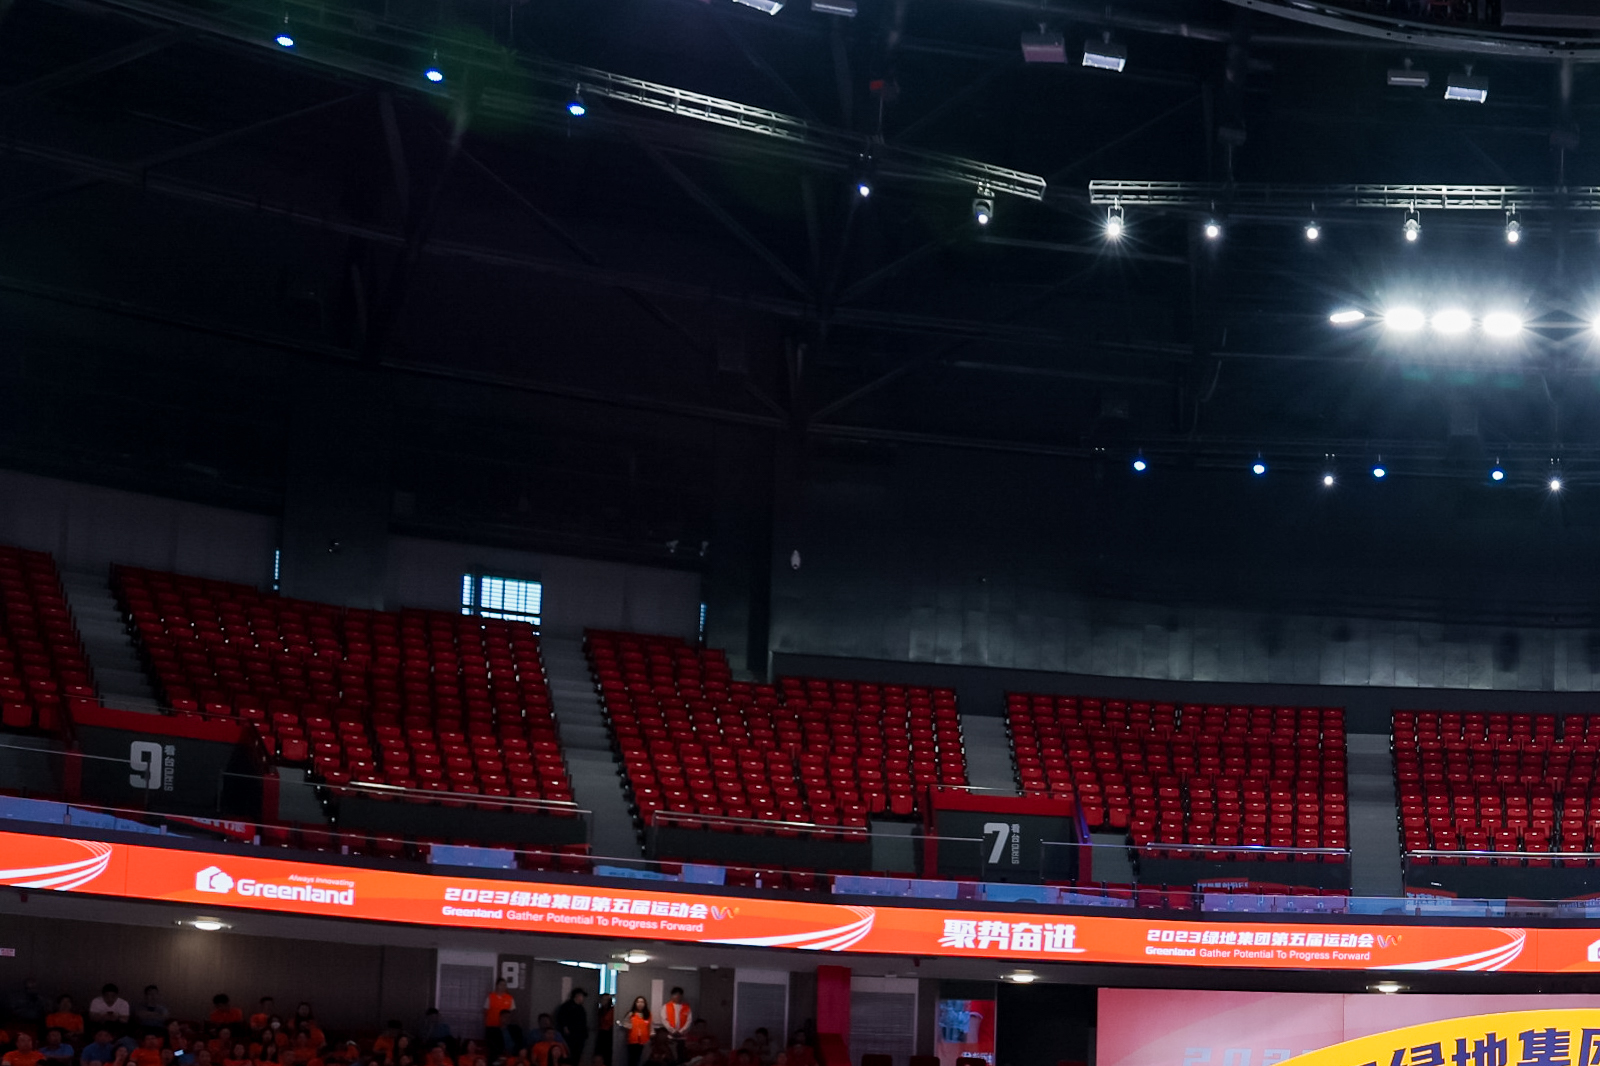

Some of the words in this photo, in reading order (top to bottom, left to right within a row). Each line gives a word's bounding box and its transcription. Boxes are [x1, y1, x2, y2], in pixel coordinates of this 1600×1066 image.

[130, 741, 162, 789] 9
[984, 823, 1010, 864] 7
[236, 878, 354, 905] Greenland
[288, 874, 315, 884] Always
[444, 887, 708, 920] 2023绿地集团第五届运动会
[442, 906, 503, 920] Greenland
[506, 910, 543, 922] Gather
[547, 913, 594, 925] Potential
[597, 915, 609, 926] To
[611, 917, 658, 930] Progress
[660, 920, 704, 933] Forward
[937, 919, 1086, 953] 聚势奋进
[1147, 929, 1374, 949] 2023绿地集团第五届运动会
[1145, 946, 1196, 957] Greenland
[1199, 948, 1231, 959] Gather
[1233, 949, 1275, 959] Potential
[1277, 950, 1288, 959] To
[1289, 950, 1330, 962] Progress
[1332, 950, 1370, 960] Forward
